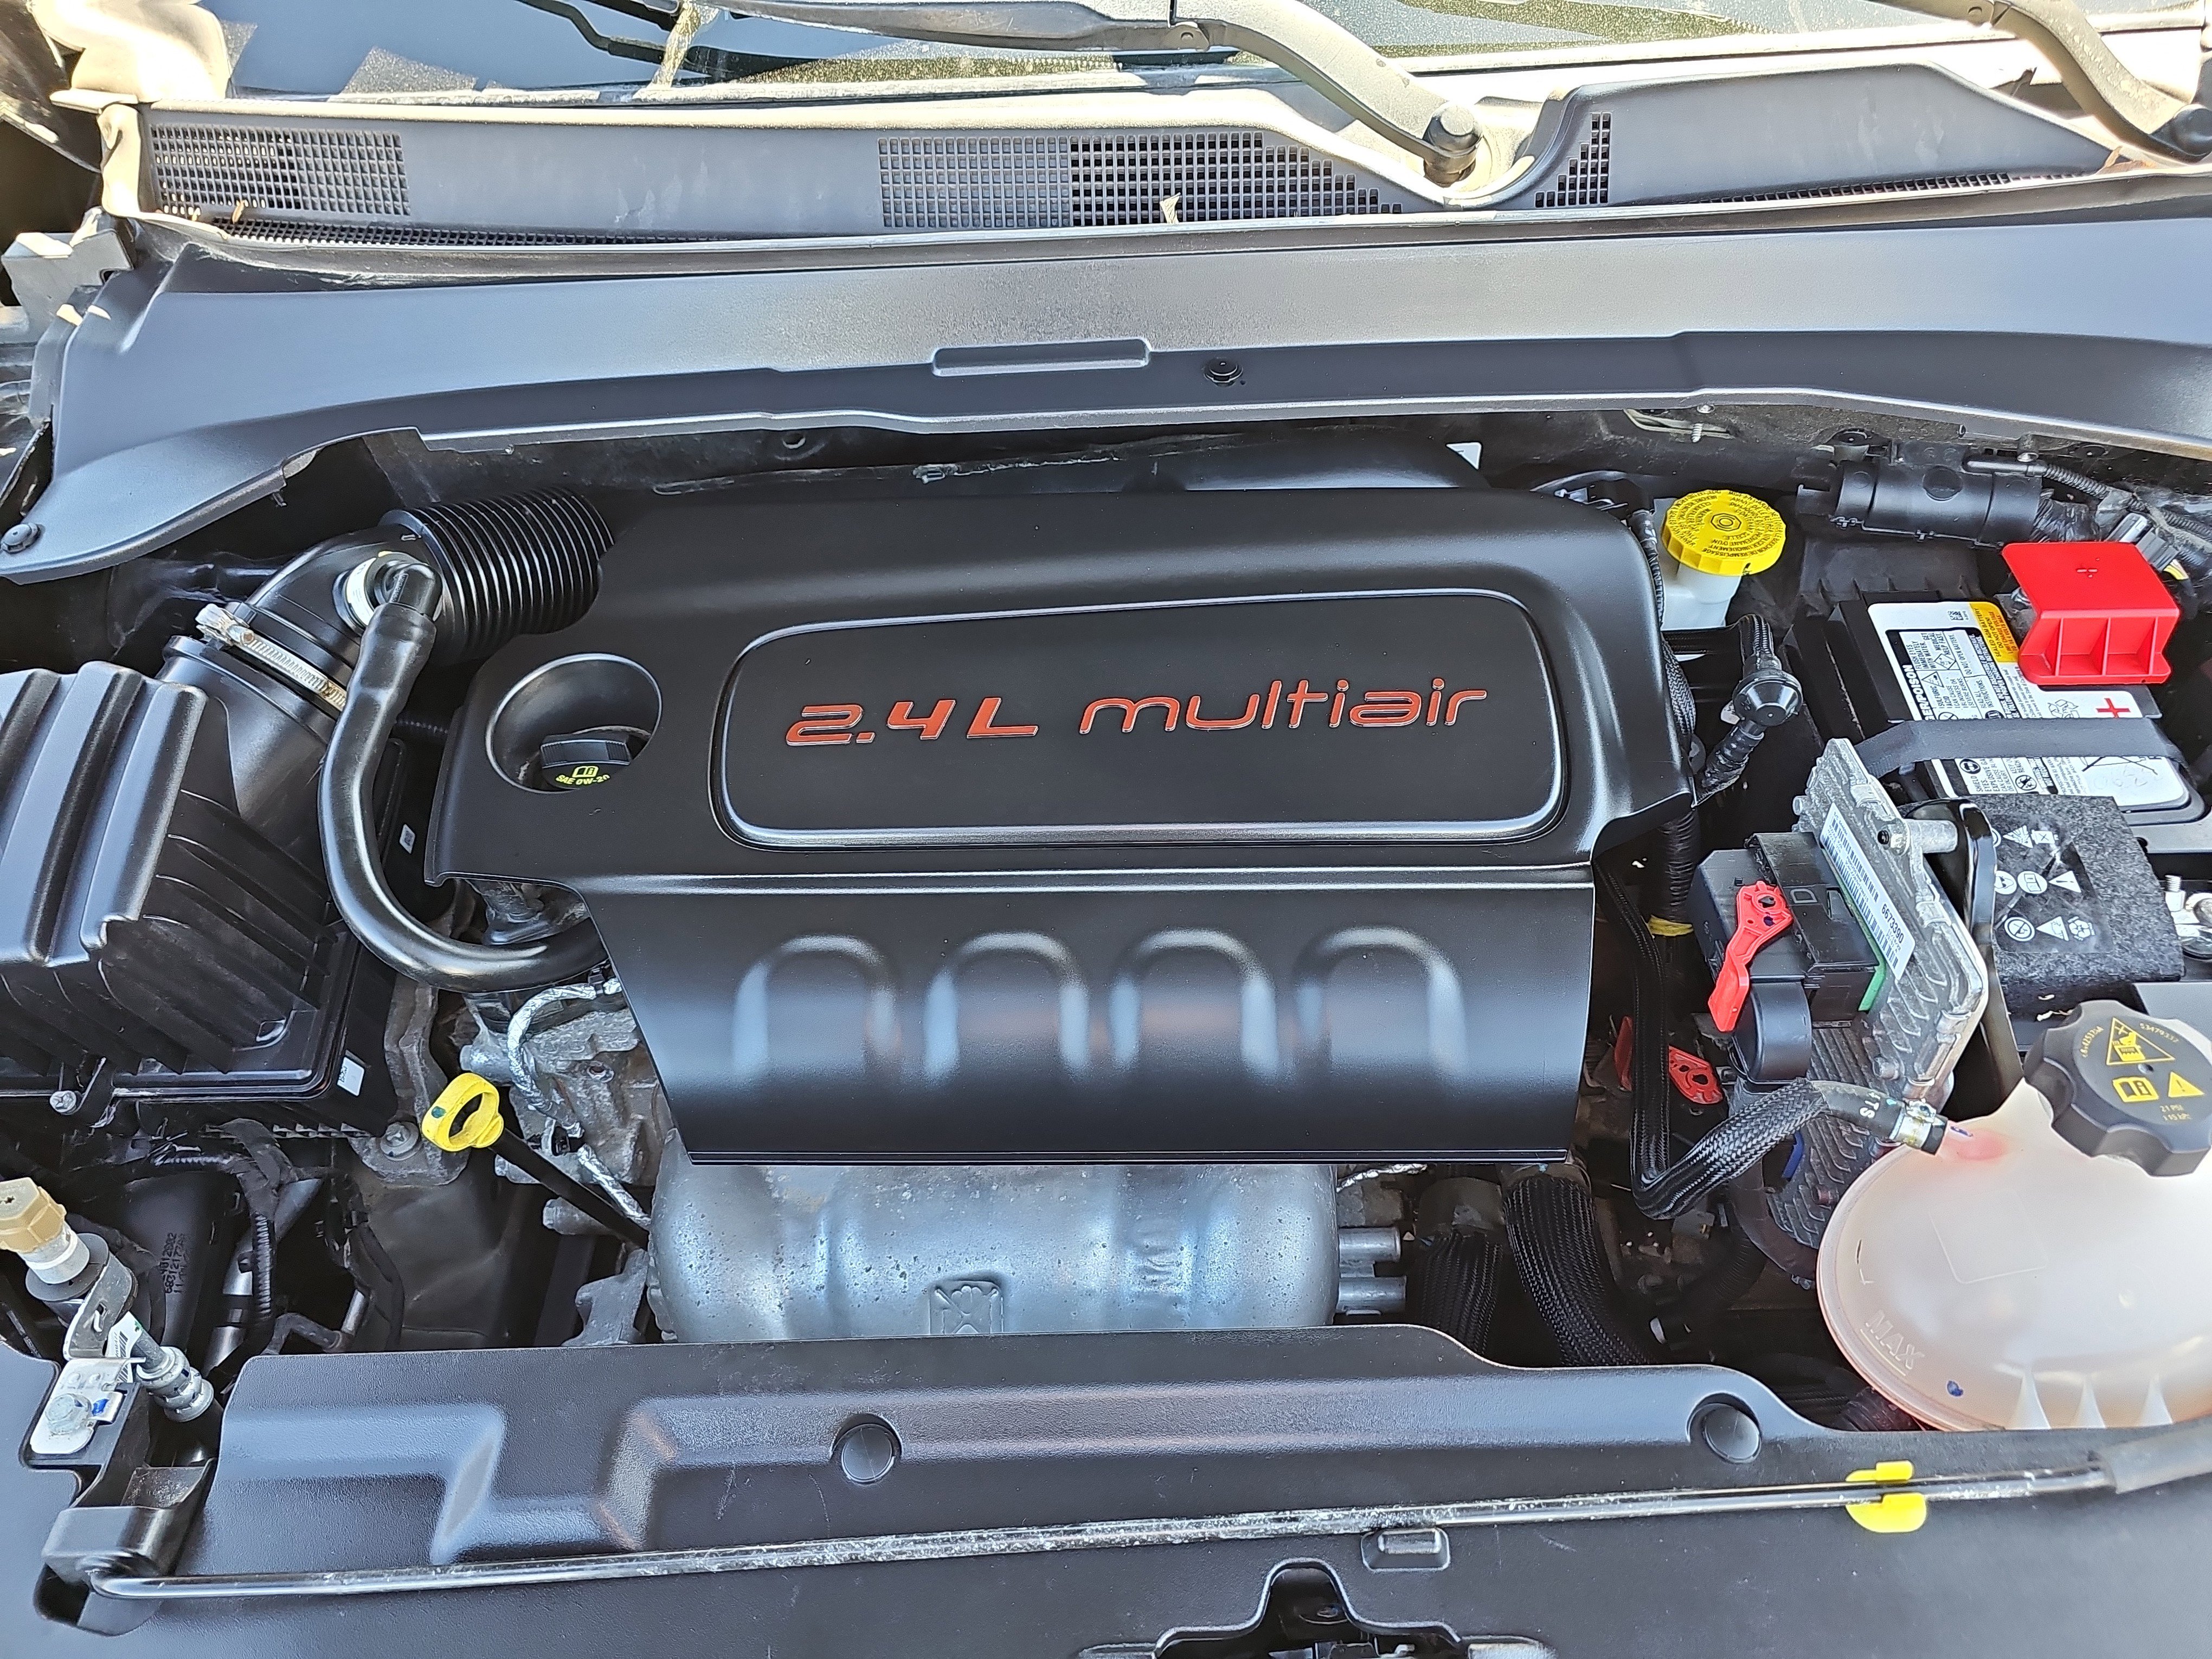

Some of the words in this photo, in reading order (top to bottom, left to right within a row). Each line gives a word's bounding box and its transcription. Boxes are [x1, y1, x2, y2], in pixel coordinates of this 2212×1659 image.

[1701, 547, 1749, 557] REMPLISSAGE
[1973, 607, 1988, 627] BATTERY
[1920, 632, 1930, 640] GET
[1983, 628, 1992, 638] AGM
[1991, 632, 2001, 640] NOT
[1905, 644, 1917, 655] EYES
[1918, 641, 1932, 657] WATER.
[1927, 632, 1942, 651] MEDICAL
[1988, 639, 2002, 657] SEALED
[1911, 641, 1930, 668] IMMEDIATELY
[1911, 656, 1922, 668] FLUSH
[1926, 658, 1937, 668] WITH
[1900, 665, 1936, 719] GER/POISON
[1929, 685, 1945, 706] SULFURIC
[1079, 678, 1488, 733] multiair
[1941, 696, 1953, 706] ACID
[2003, 695, 2017, 711] FOLLOW
[556, 774, 576, 785] SAE
[1969, 775, 1984, 792] SHIELD
[1979, 778, 1992, 792] EYES.
[1982, 766, 2001, 792] EXPLOSIVE
[1882, 903, 1904, 944] 6673390
[1865, 1310, 1925, 1370] MAX
